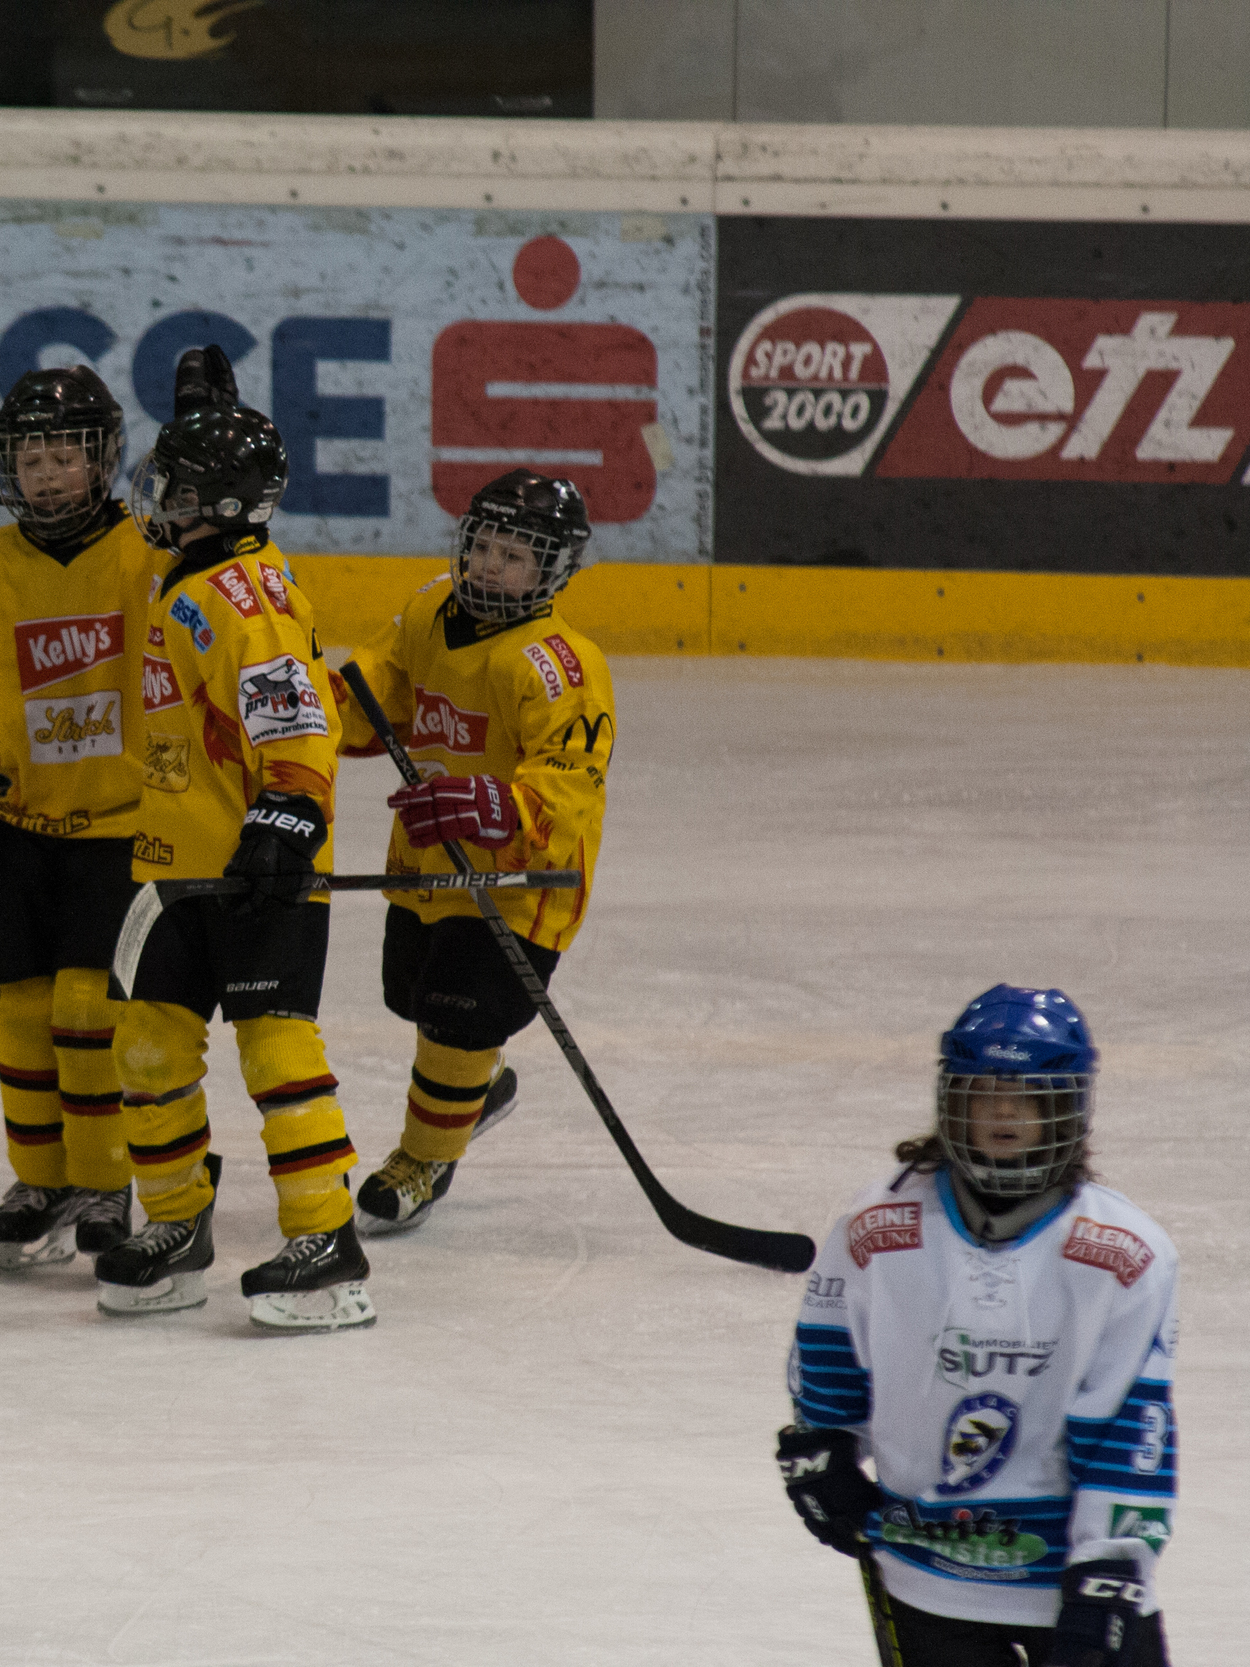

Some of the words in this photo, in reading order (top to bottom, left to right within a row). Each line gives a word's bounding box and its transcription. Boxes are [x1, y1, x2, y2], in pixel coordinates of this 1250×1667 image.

[750, 340, 874, 382] SPORT
[762, 389, 871, 432] 2000
[218, 567, 255, 610] Kelly's
[28, 622, 112, 671] Kelly's
[142, 665, 173, 705] lly's
[526, 646, 563, 699] RICOH
[413, 702, 471, 747] Kelly's
[385, 735, 417, 784] NEXU
[243, 808, 316, 838] AUER
[226, 979, 280, 993] BAUER
[986, 1045, 1034, 1063] Reebok
[850, 1205, 918, 1246] KLEINE
[1075, 1222, 1151, 1268] KLEINE
[1068, 1243, 1136, 1284] ZEITUNG
[779, 1450, 832, 1478] CM
